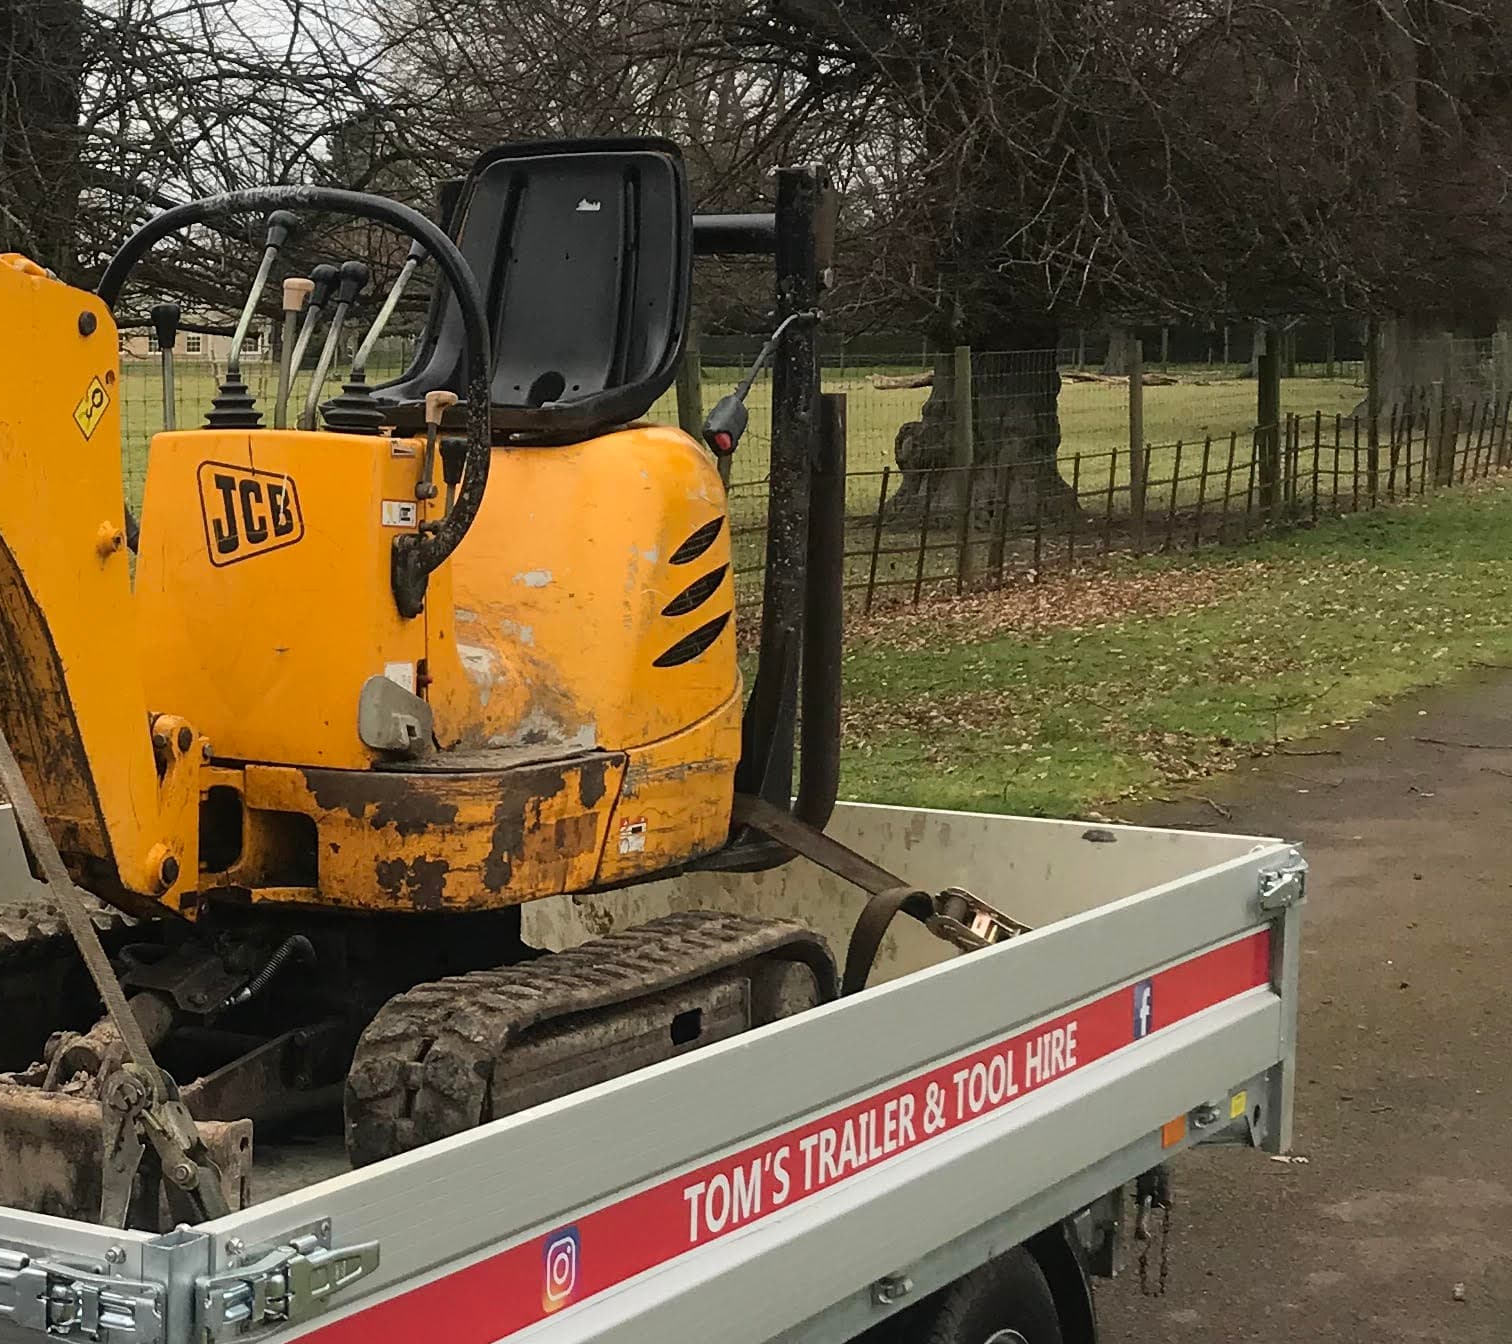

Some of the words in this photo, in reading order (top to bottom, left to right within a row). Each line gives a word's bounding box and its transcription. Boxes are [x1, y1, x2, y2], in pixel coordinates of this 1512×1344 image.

[212, 473, 294, 554] JCB
[684, 1146, 790, 1243] TOM'S
[799, 1093, 917, 1191] TRAILER
[923, 1081, 946, 1133] &
[953, 1050, 1019, 1120] TOOL
[1025, 1021, 1078, 1087] HIRE
